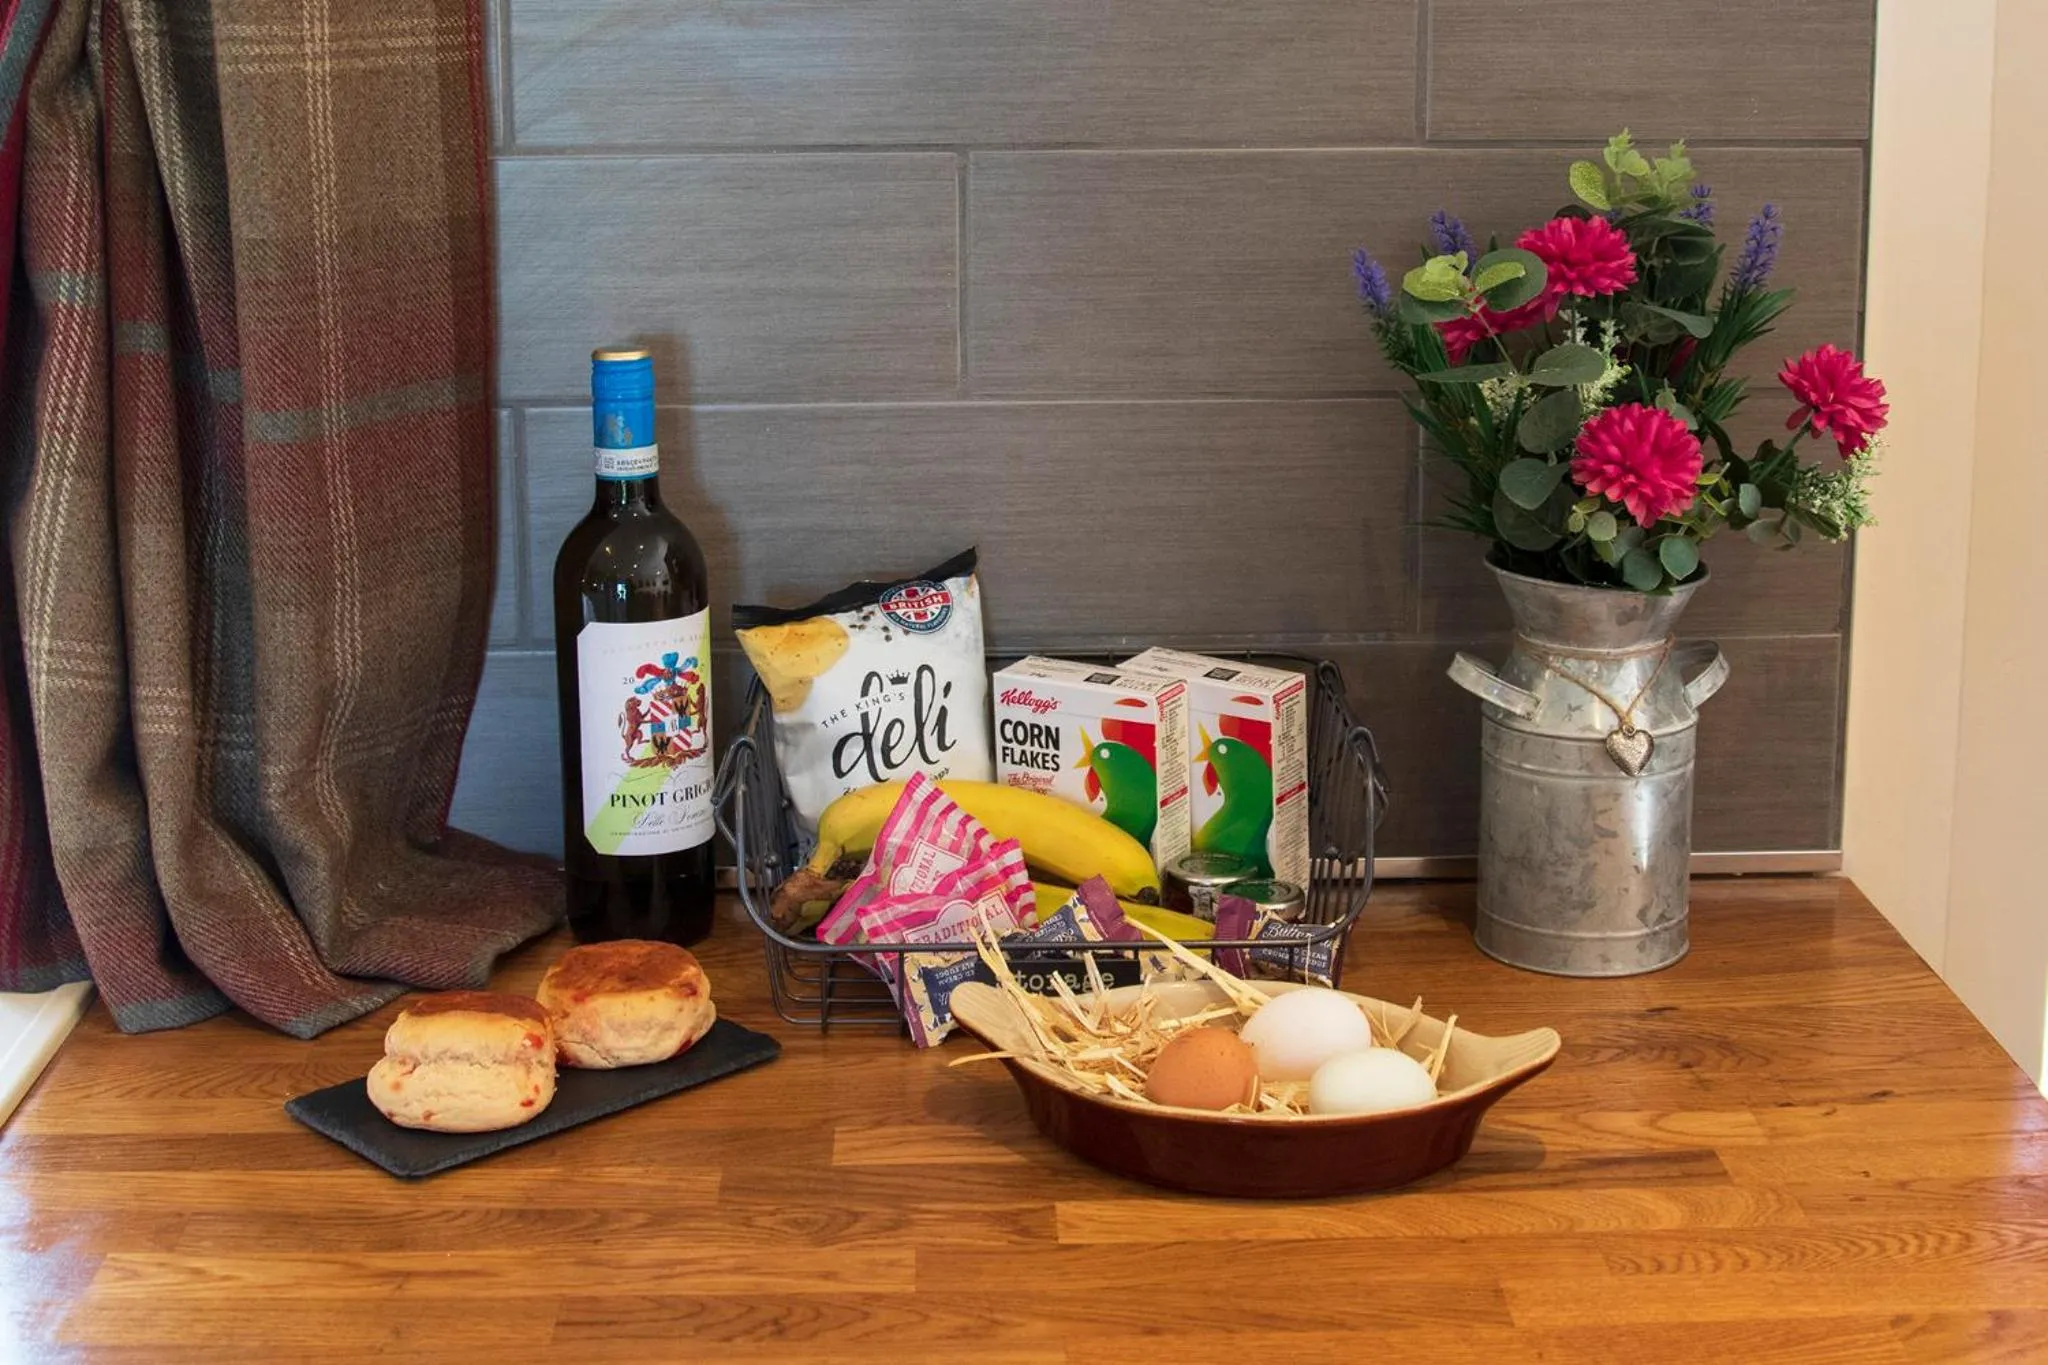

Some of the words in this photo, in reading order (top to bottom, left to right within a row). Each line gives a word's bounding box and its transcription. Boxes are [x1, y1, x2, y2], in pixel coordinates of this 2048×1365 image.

[889, 594, 944, 609] BRITISH
[821, 709, 848, 728] THE
[855, 692, 905, 711] KING'S
[1000, 688, 1058, 714] Kellogg's
[832, 664, 957, 783] deli
[1000, 718, 1060, 751] CORN
[1002, 745, 1060, 772] FLAKES
[610, 791, 668, 808] PINOT
[909, 851, 937, 892] TIONAL
[912, 904, 1004, 944] RADITIOAL
[1015, 970, 1115, 994] torage
